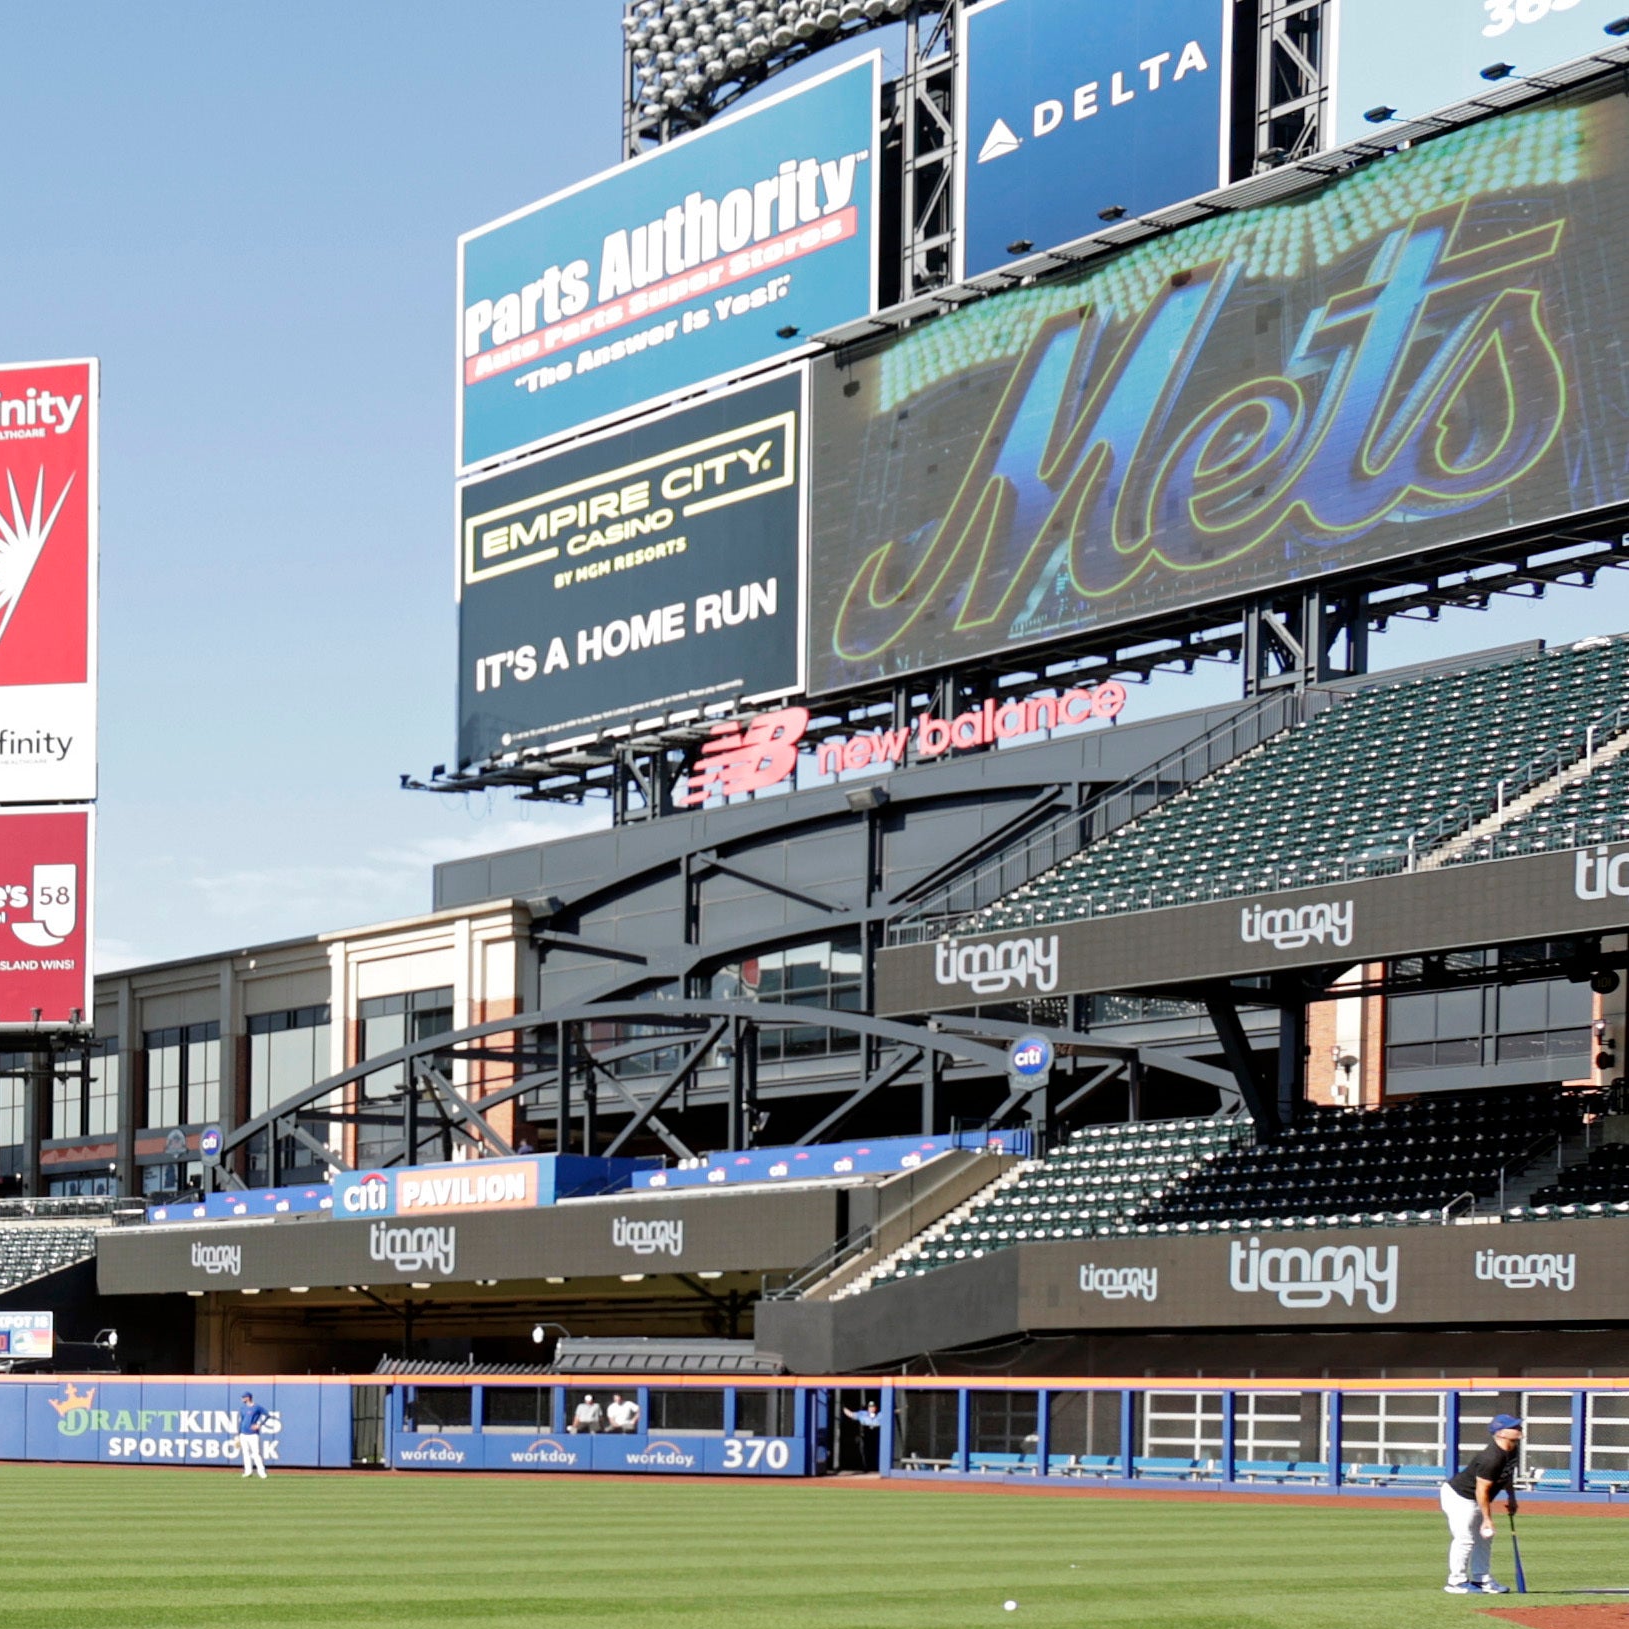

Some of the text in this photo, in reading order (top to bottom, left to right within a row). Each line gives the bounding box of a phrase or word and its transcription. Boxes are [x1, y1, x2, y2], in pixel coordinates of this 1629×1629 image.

[1033, 38, 1211, 138] DELTA
[465, 258, 590, 358] Parts
[597, 153, 857, 303] Authority
[475, 218, 842, 378] Auto Parts Super Stores
[576, 320, 678, 374] Answer
[681, 308, 710, 334] Is
[831, 200, 1568, 662] Mets
[482, 440, 773, 559] EMPIRE CITY
[566, 508, 674, 557] CASINO
[554, 536, 687, 589] BY MGM RESORTS
[475, 577, 778, 692] IT'S A HOME RUN
[817, 726, 911, 776] new
[919, 681, 1127, 756] balance
[39, 887, 70, 905] 58
[1241, 900, 1354, 950] timmy
[41, 960, 74, 970] WINS!
[935, 935, 1059, 995] timmy
[343, 1172, 526, 1213] citi PAVILION
[369, 1222, 456, 1275] timmy
[1474, 1248, 1576, 1292] timmy
[1079, 1262, 1158, 1302] timmy
[1229, 1236, 1399, 1314] timmy
[34, 1316, 48, 1328] IS
[57, 1408, 281, 1436] DRAFTKINS
[108, 1436, 279, 1461] SPORTSBOK
[400, 1447, 464, 1464] workday
[511, 1448, 577, 1466] workday
[626, 1450, 693, 1468] workday
[722, 1440, 789, 1469] 370
